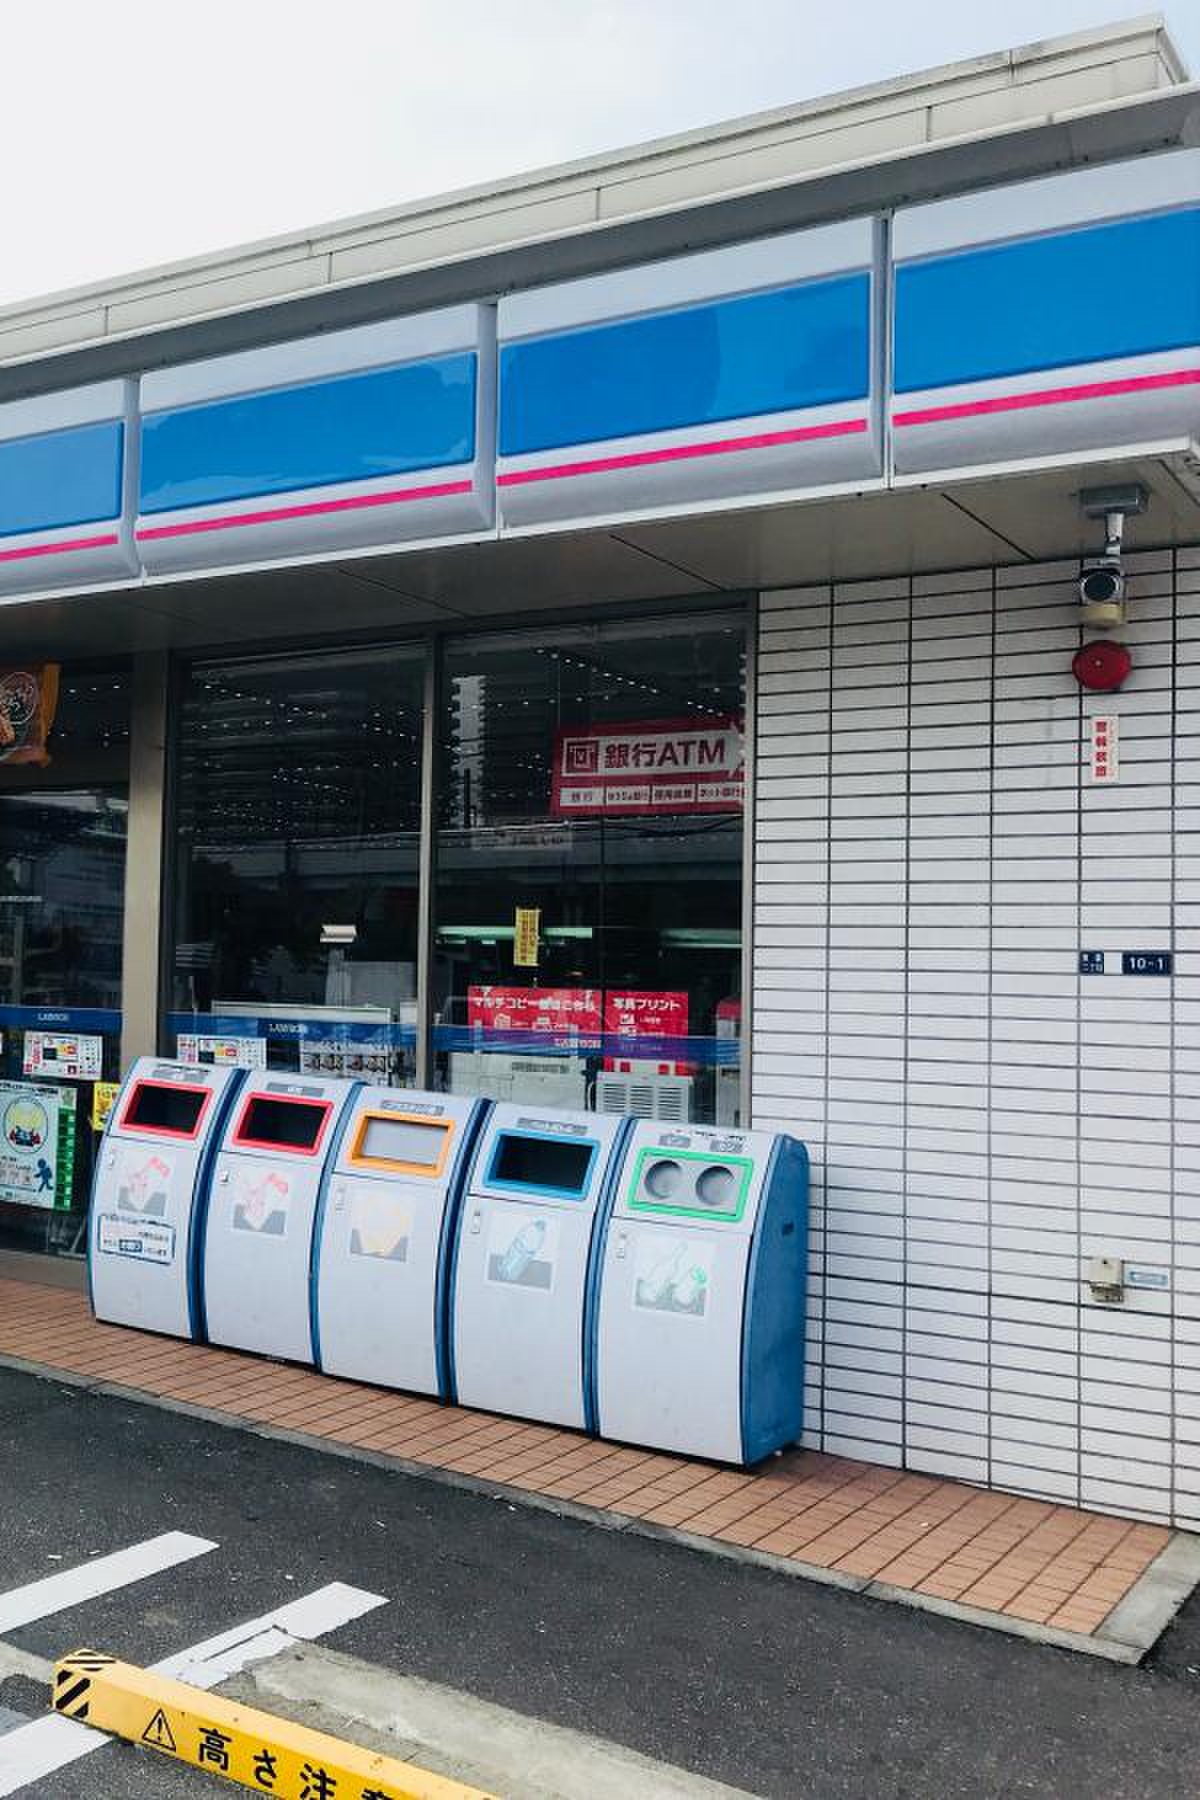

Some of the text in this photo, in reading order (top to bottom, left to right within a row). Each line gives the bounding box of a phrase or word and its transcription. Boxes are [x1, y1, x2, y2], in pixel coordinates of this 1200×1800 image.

[1129, 957, 1164, 970] 10-1
[198, 1726, 395, 1800] 高さ注
